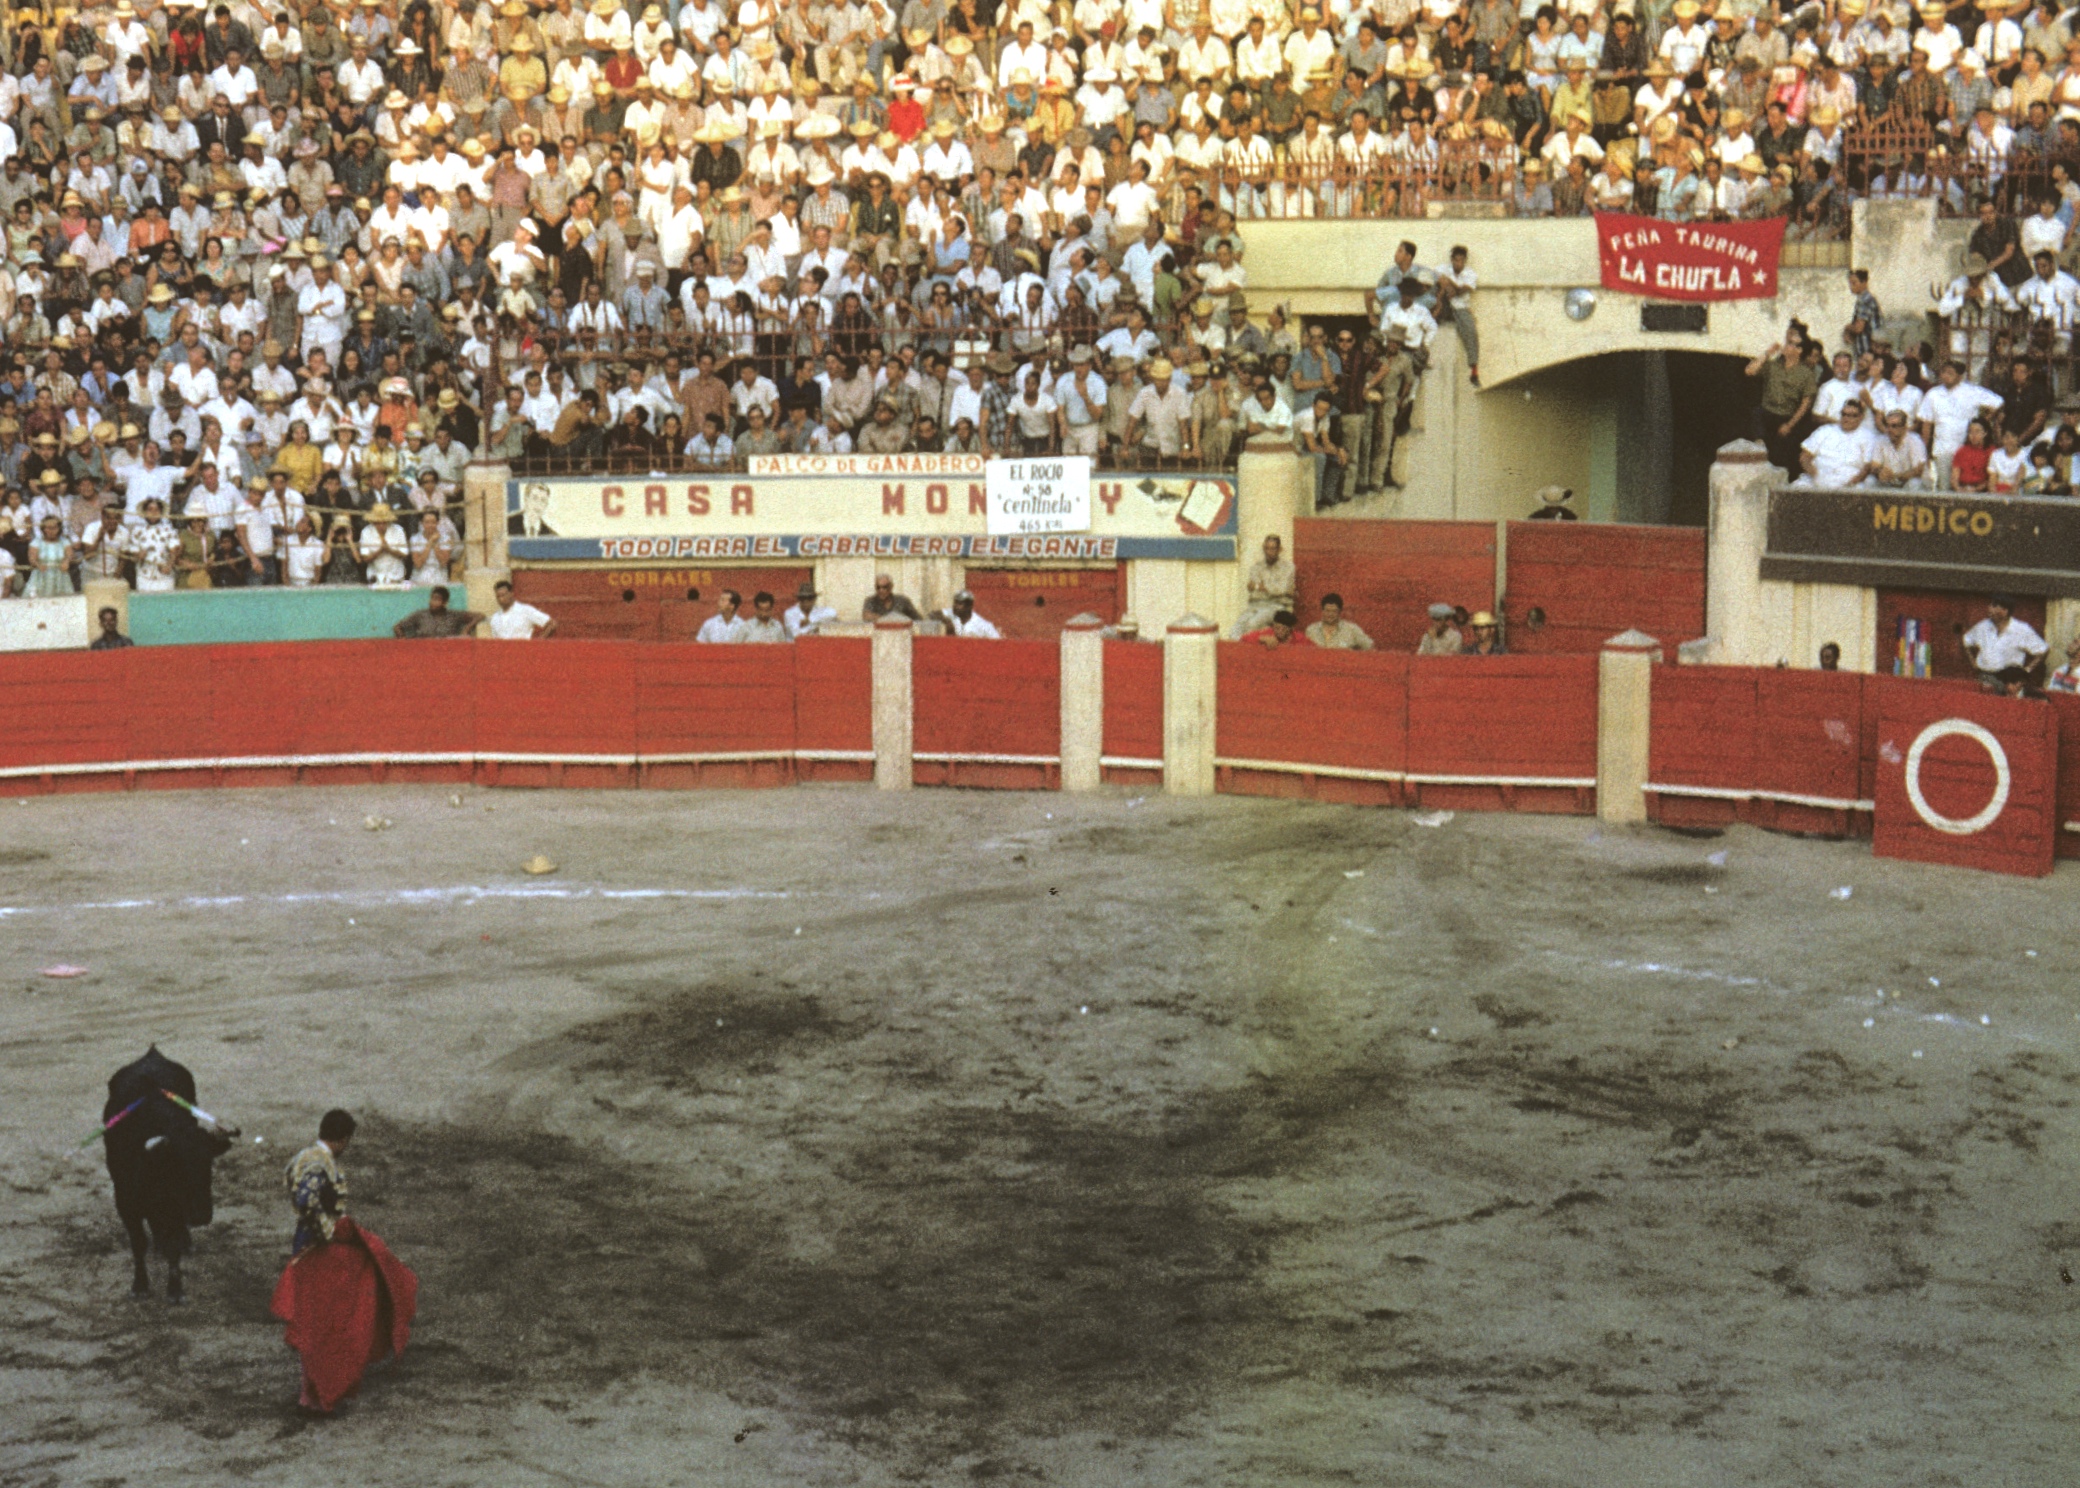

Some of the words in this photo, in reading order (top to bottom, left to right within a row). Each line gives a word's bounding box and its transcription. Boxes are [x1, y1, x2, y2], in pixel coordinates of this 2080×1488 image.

[1675, 228, 1759, 265] TAURINA
[1619, 255, 1646, 285] LA
[1656, 262, 1741, 292] CHUFLA
[756, 455, 827, 474] PALCO
[836, 458, 858, 474] DE
[1010, 464, 1024, 480] EL
[601, 484, 754, 517] CASA
[1873, 504, 1994, 537] MEDICO
[601, 537, 673, 558] TODO
[676, 537, 748, 557] PARA
[752, 535, 789, 556] EL
[799, 535, 963, 556] CABALLERO
[969, 536, 1117, 557] ELEGANTE
[608, 571, 713, 587] CORRALES
[1007, 573, 1079, 588] TORILES
